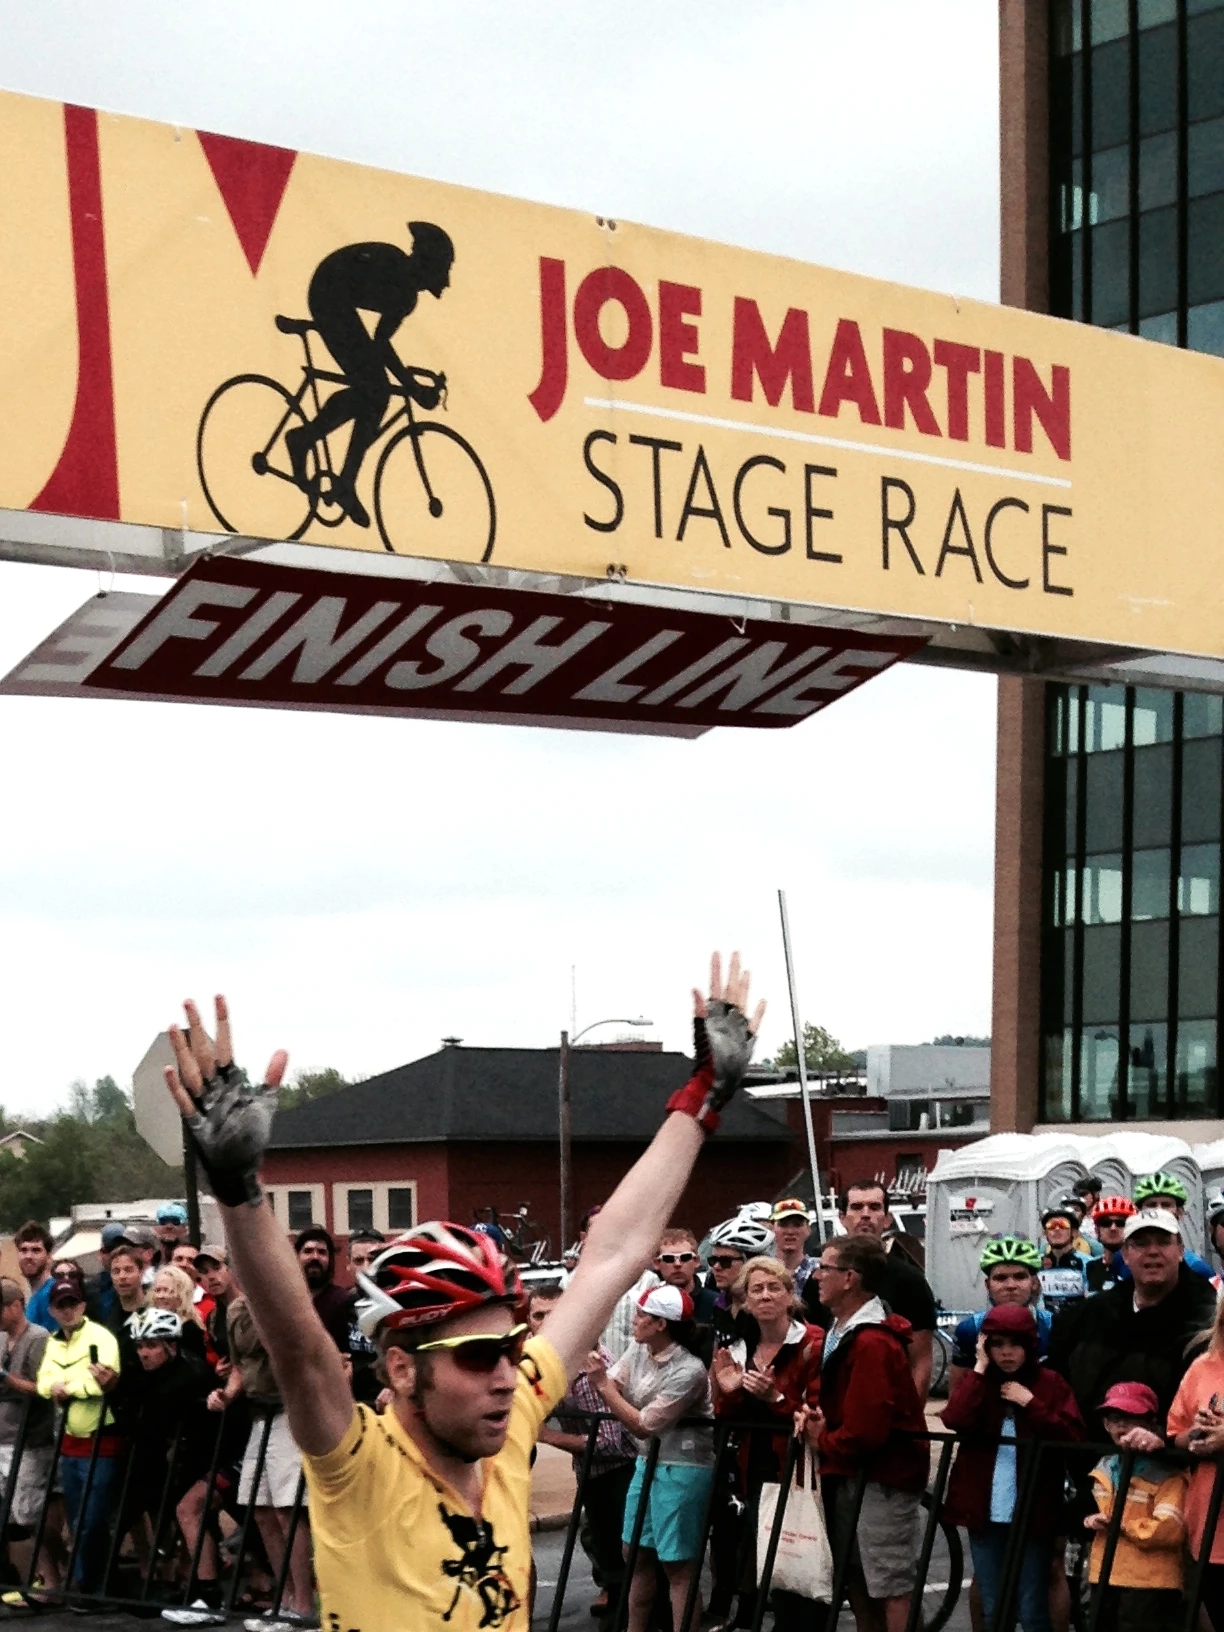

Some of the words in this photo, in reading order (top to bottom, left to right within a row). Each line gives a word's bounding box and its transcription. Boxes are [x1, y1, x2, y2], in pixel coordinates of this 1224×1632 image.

[528, 254, 706, 423] JOE
[731, 297, 1072, 462] MARTIN
[582, 429, 842, 564] STAGE
[880, 477, 1074, 597] RACE
[110, 578, 594, 702] FINISH
[573, 632, 894, 718] LINE
